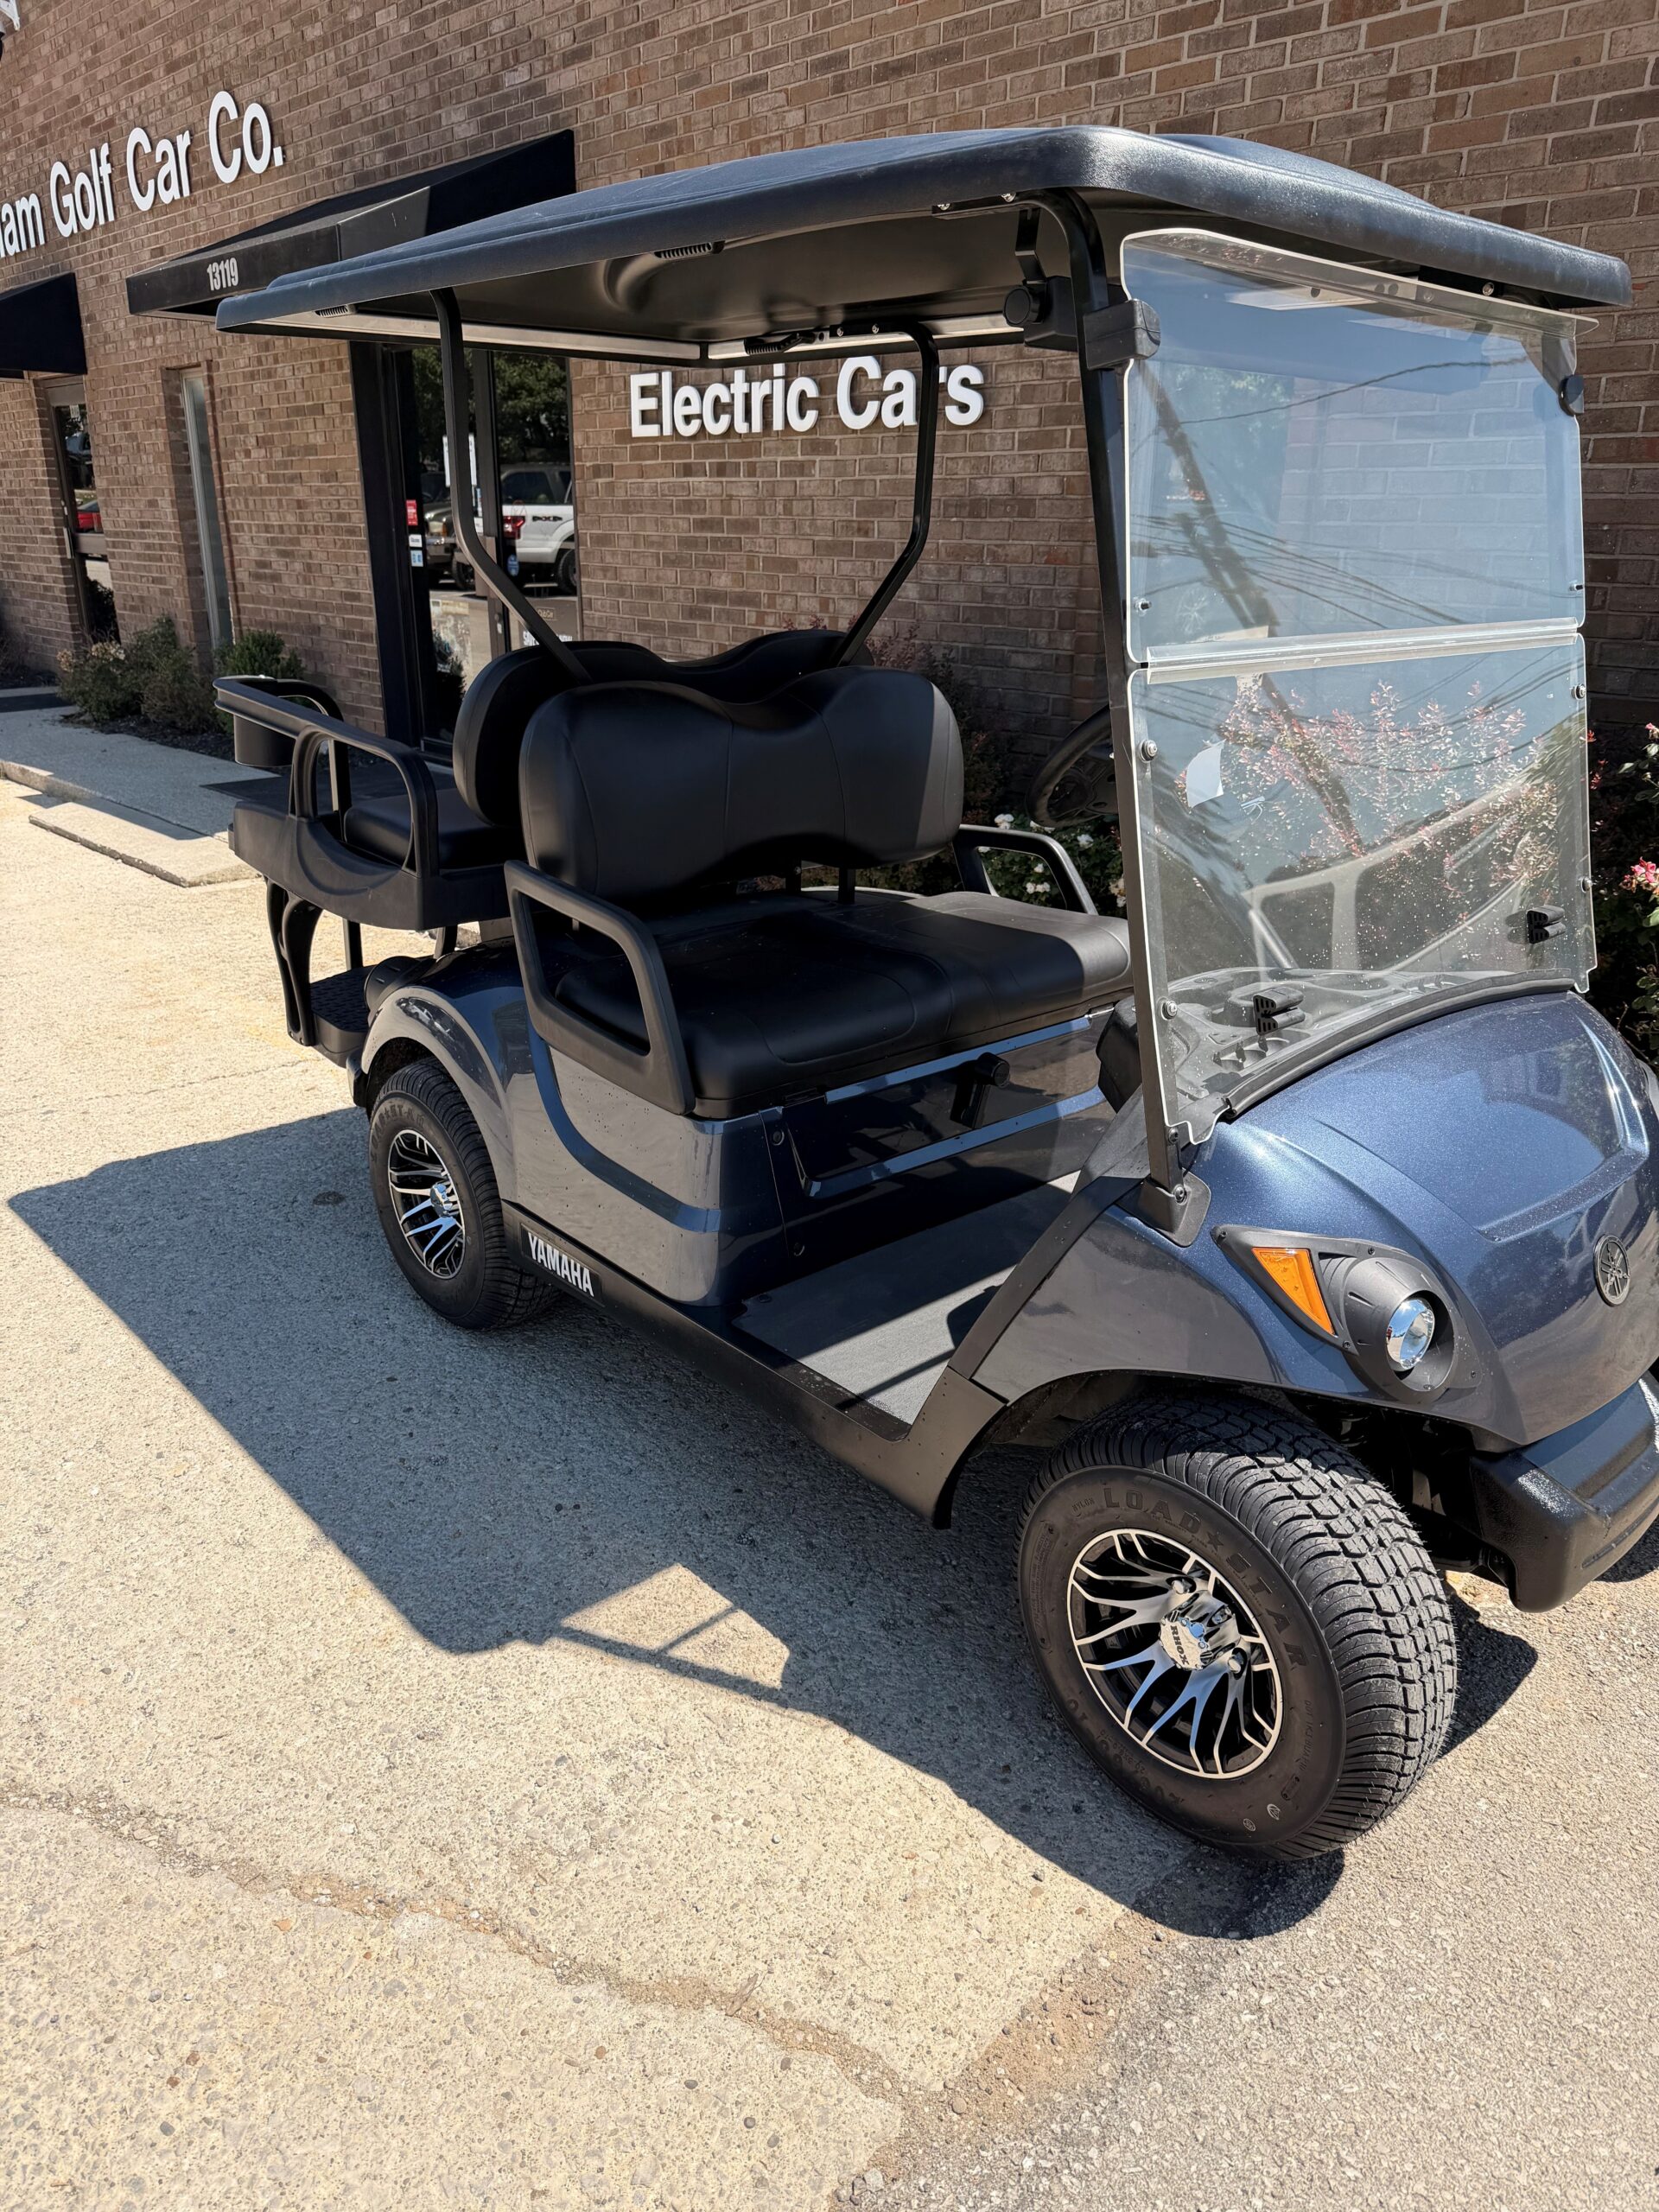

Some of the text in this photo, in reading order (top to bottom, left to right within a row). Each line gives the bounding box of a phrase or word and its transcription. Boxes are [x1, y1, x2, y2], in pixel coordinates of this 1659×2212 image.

[0, 90, 283, 258] am Golf Car Co.
[207, 257, 239, 291] 13119
[630, 356, 984, 437] Electric Cas
[528, 1231, 594, 1298] YAMAHA
[1104, 1487, 1202, 1535] LOAD
[1225, 1553, 1310, 1666] STAR
[1170, 1624, 1190, 1666] RHOX
